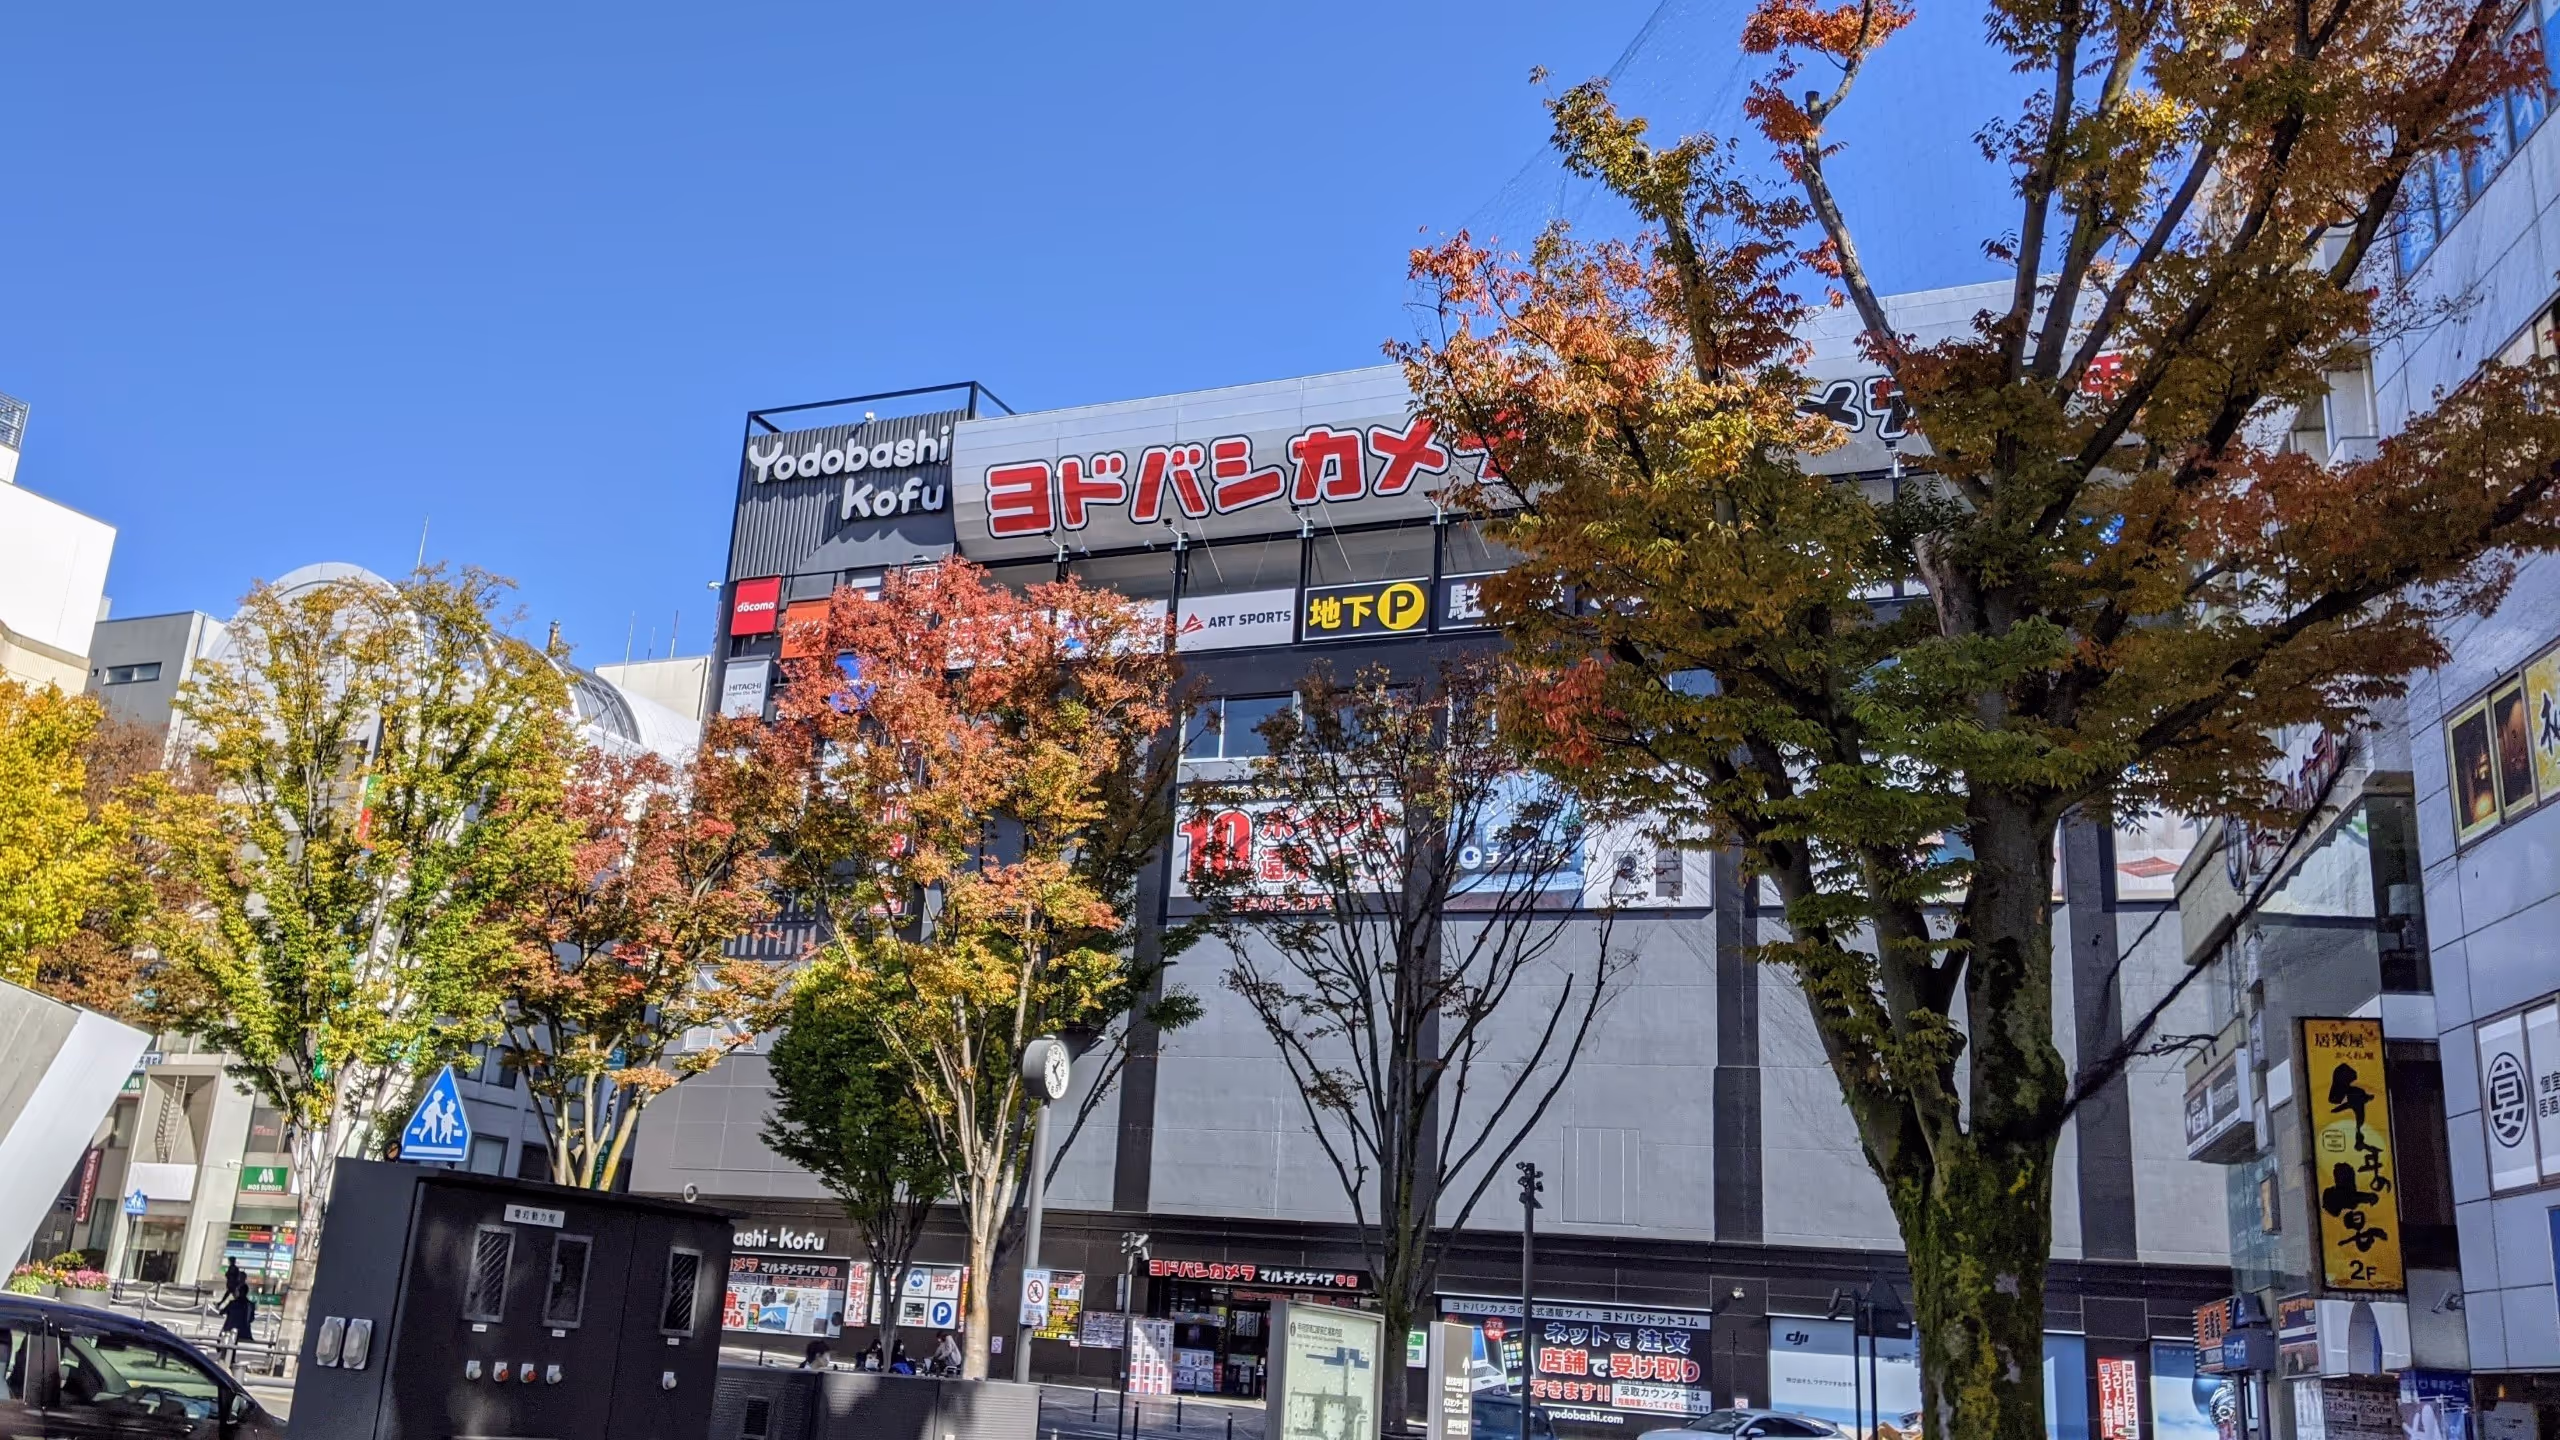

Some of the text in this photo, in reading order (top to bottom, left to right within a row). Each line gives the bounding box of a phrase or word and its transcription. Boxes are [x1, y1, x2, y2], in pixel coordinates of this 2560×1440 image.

[748, 425, 950, 484] Yodobashi
[841, 477, 945, 521] Kofu
[737, 602, 775, 613] docomo
[1208, 608, 1292, 629] ART SPORTS
[1309, 595, 1373, 631] 地下
[1388, 590, 1416, 625] P
[728, 682, 762, 692] HITACHI
[1179, 807, 1253, 882] 10
[1149, 1259, 1358, 1288] ヨドバシカメラ マルチメディア甲府
[2350, 1259, 2377, 1281] 2F
[937, 1306, 948, 1322] P
[1602, 1311, 1698, 1328] ヨドバシドットコム
[1545, 1323, 1691, 1354] ネットで注文
[1539, 1347, 1701, 1384] 店舗で受け取り
[1620, 1386, 1701, 1402] 受取カウンターは
[2125, 1363, 2136, 1426] ヨドバシカメラは
[1549, 1409, 1624, 1424] yodobashi.com
